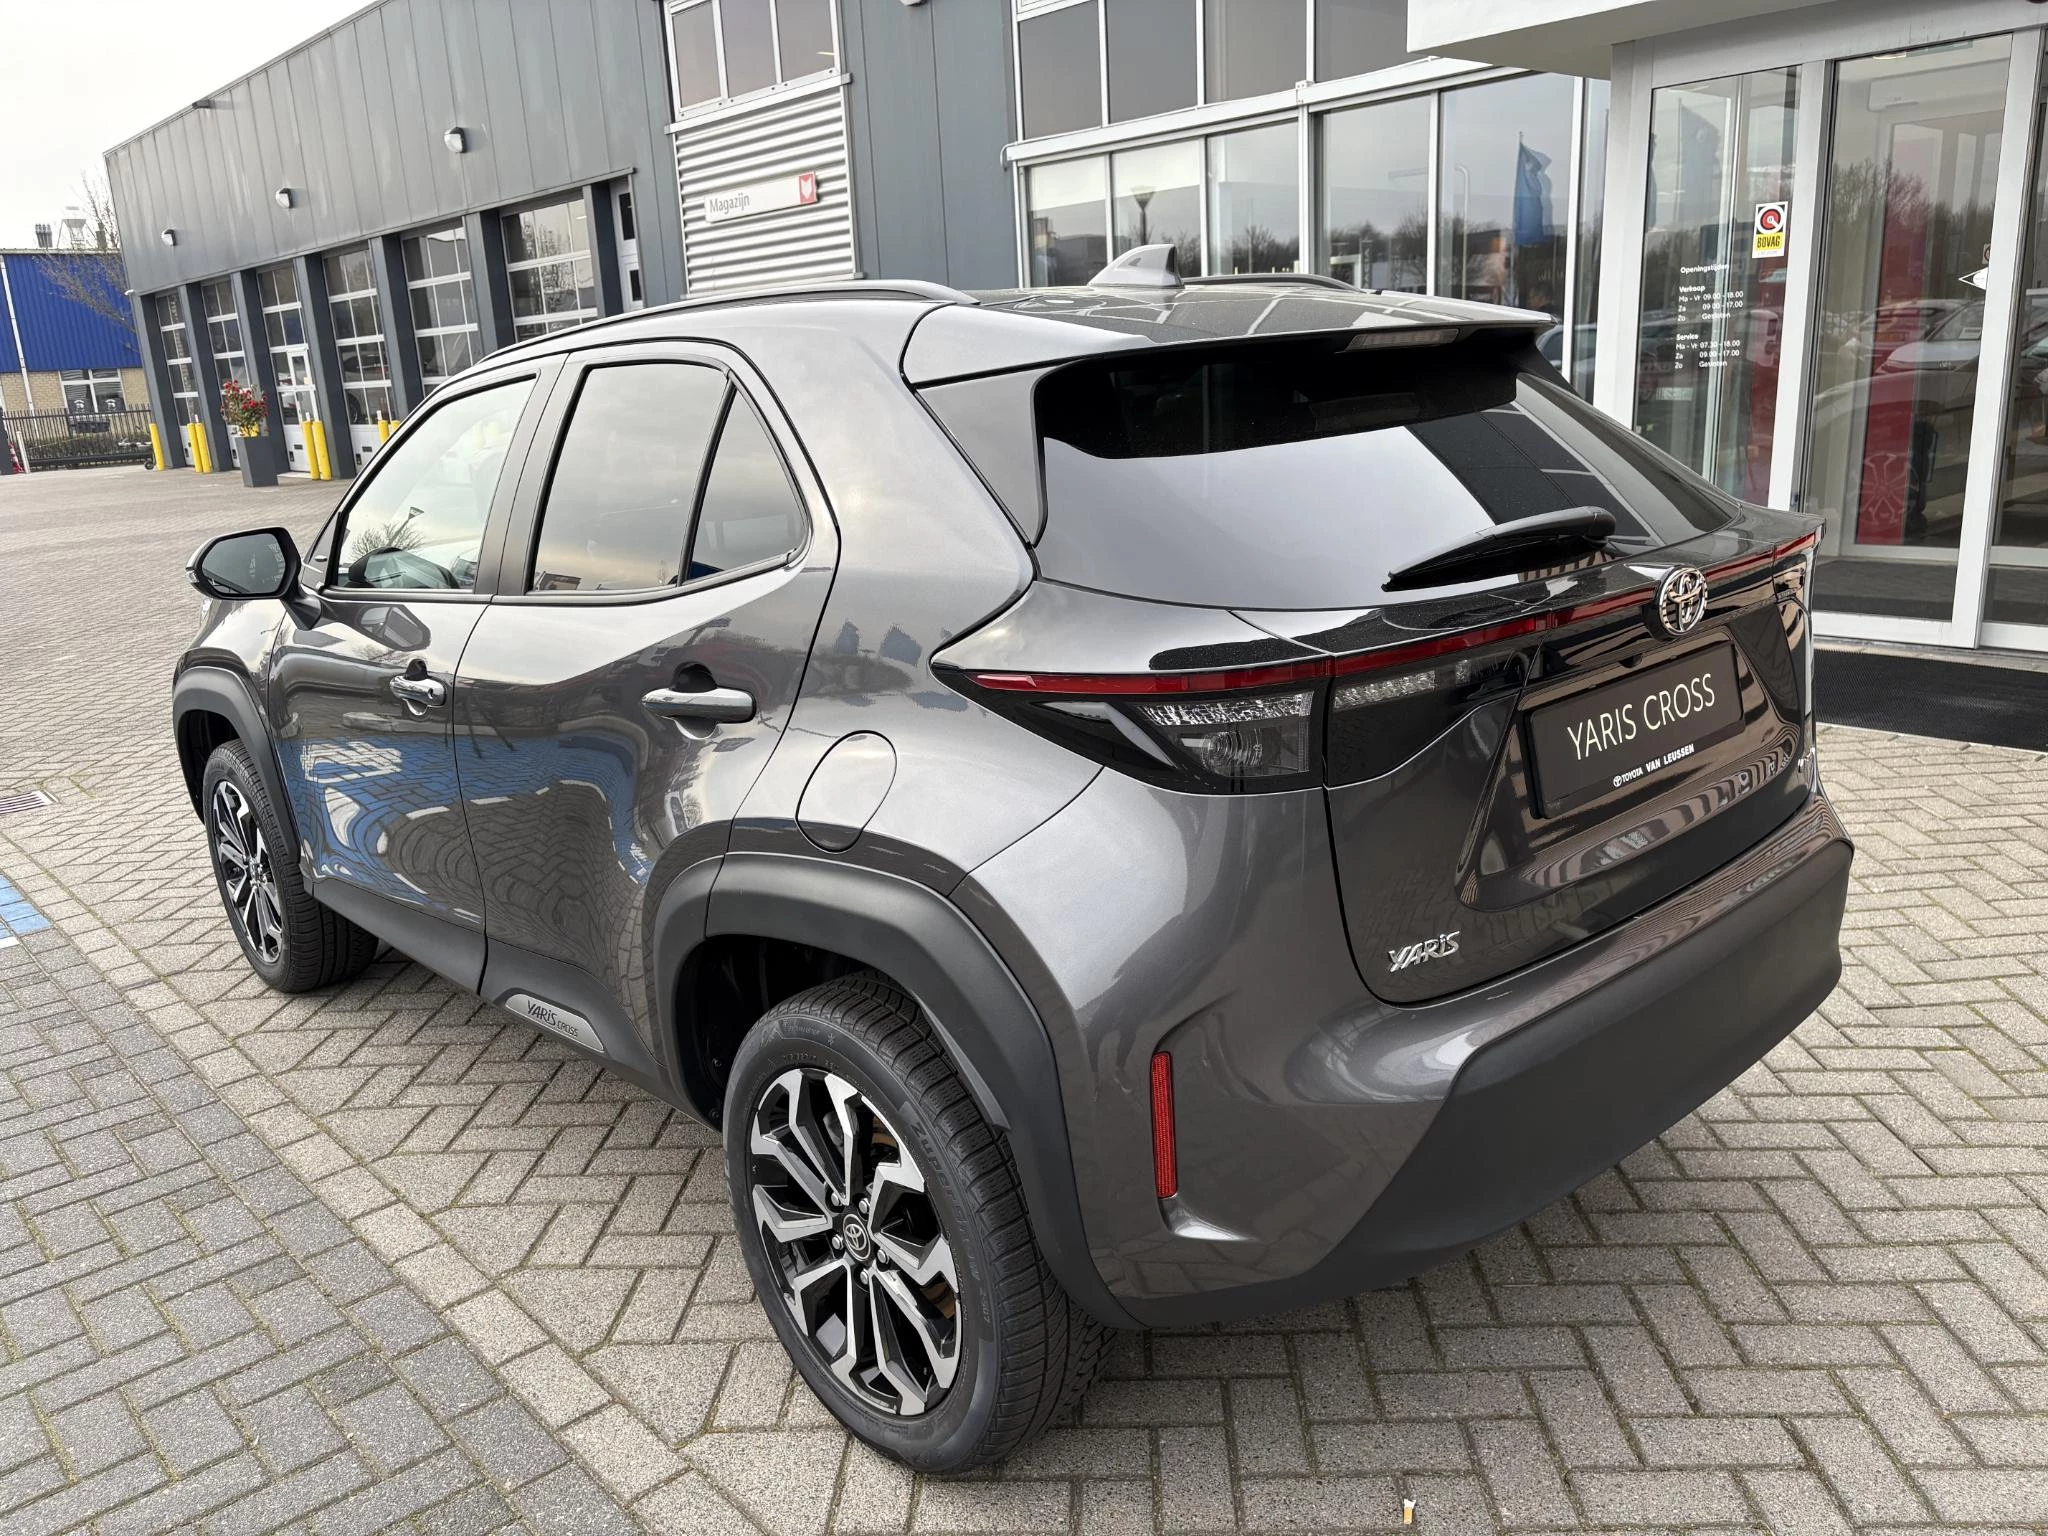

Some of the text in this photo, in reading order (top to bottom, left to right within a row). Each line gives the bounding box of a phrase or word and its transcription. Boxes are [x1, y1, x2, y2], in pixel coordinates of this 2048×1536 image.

[709, 192, 750, 214] Magazijn
[1756, 235, 1781, 249] BOVAG
[1680, 264, 1730, 275] Openingstijden
[1679, 285, 1706, 293] Verkoop
[1676, 333, 1699, 341] Service
[1567, 673, 1716, 761] YARIS CROSS
[1621, 743, 1696, 783] TOYOTA VAN LEUSSEN
[557, 1020, 579, 1038] CROSS
